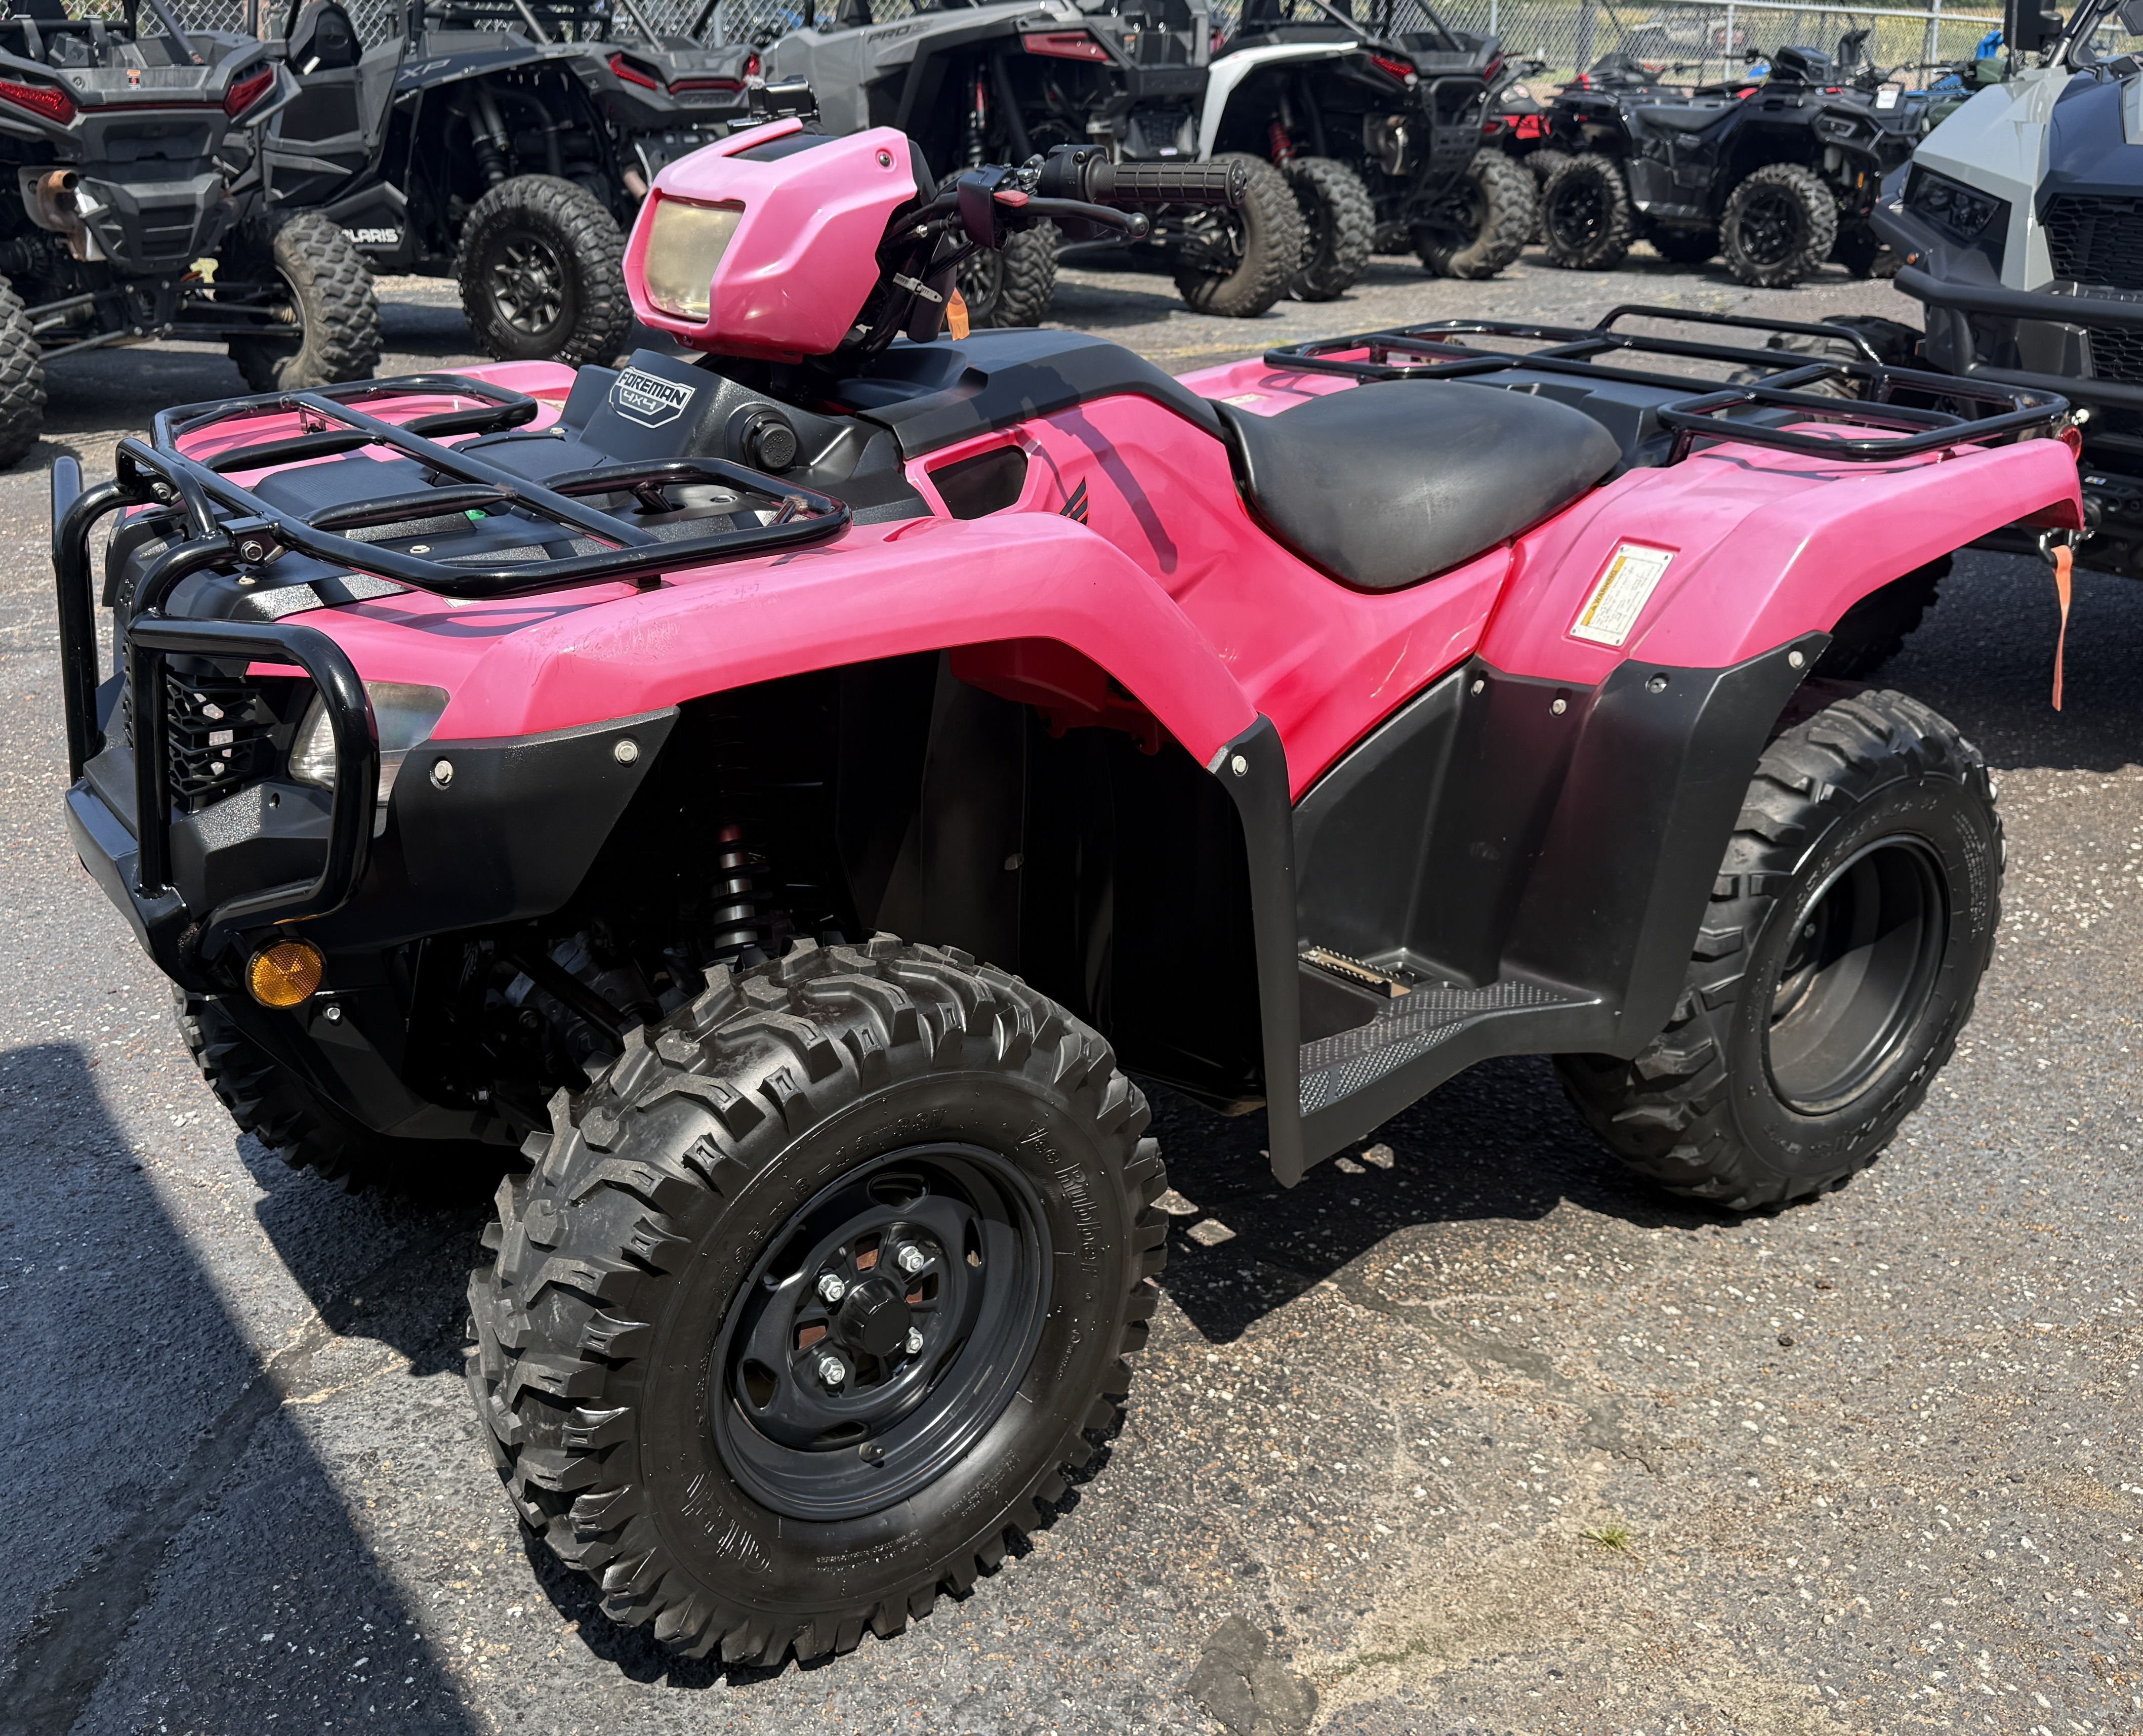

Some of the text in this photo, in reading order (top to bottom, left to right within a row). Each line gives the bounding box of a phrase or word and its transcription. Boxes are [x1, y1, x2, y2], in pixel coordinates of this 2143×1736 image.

[341, 228, 398, 243] LARIS
[619, 371, 687, 406] FOREMAN
[1595, 569, 1618, 604] WARNING
[1054, 1162, 1102, 1278] Rubber
